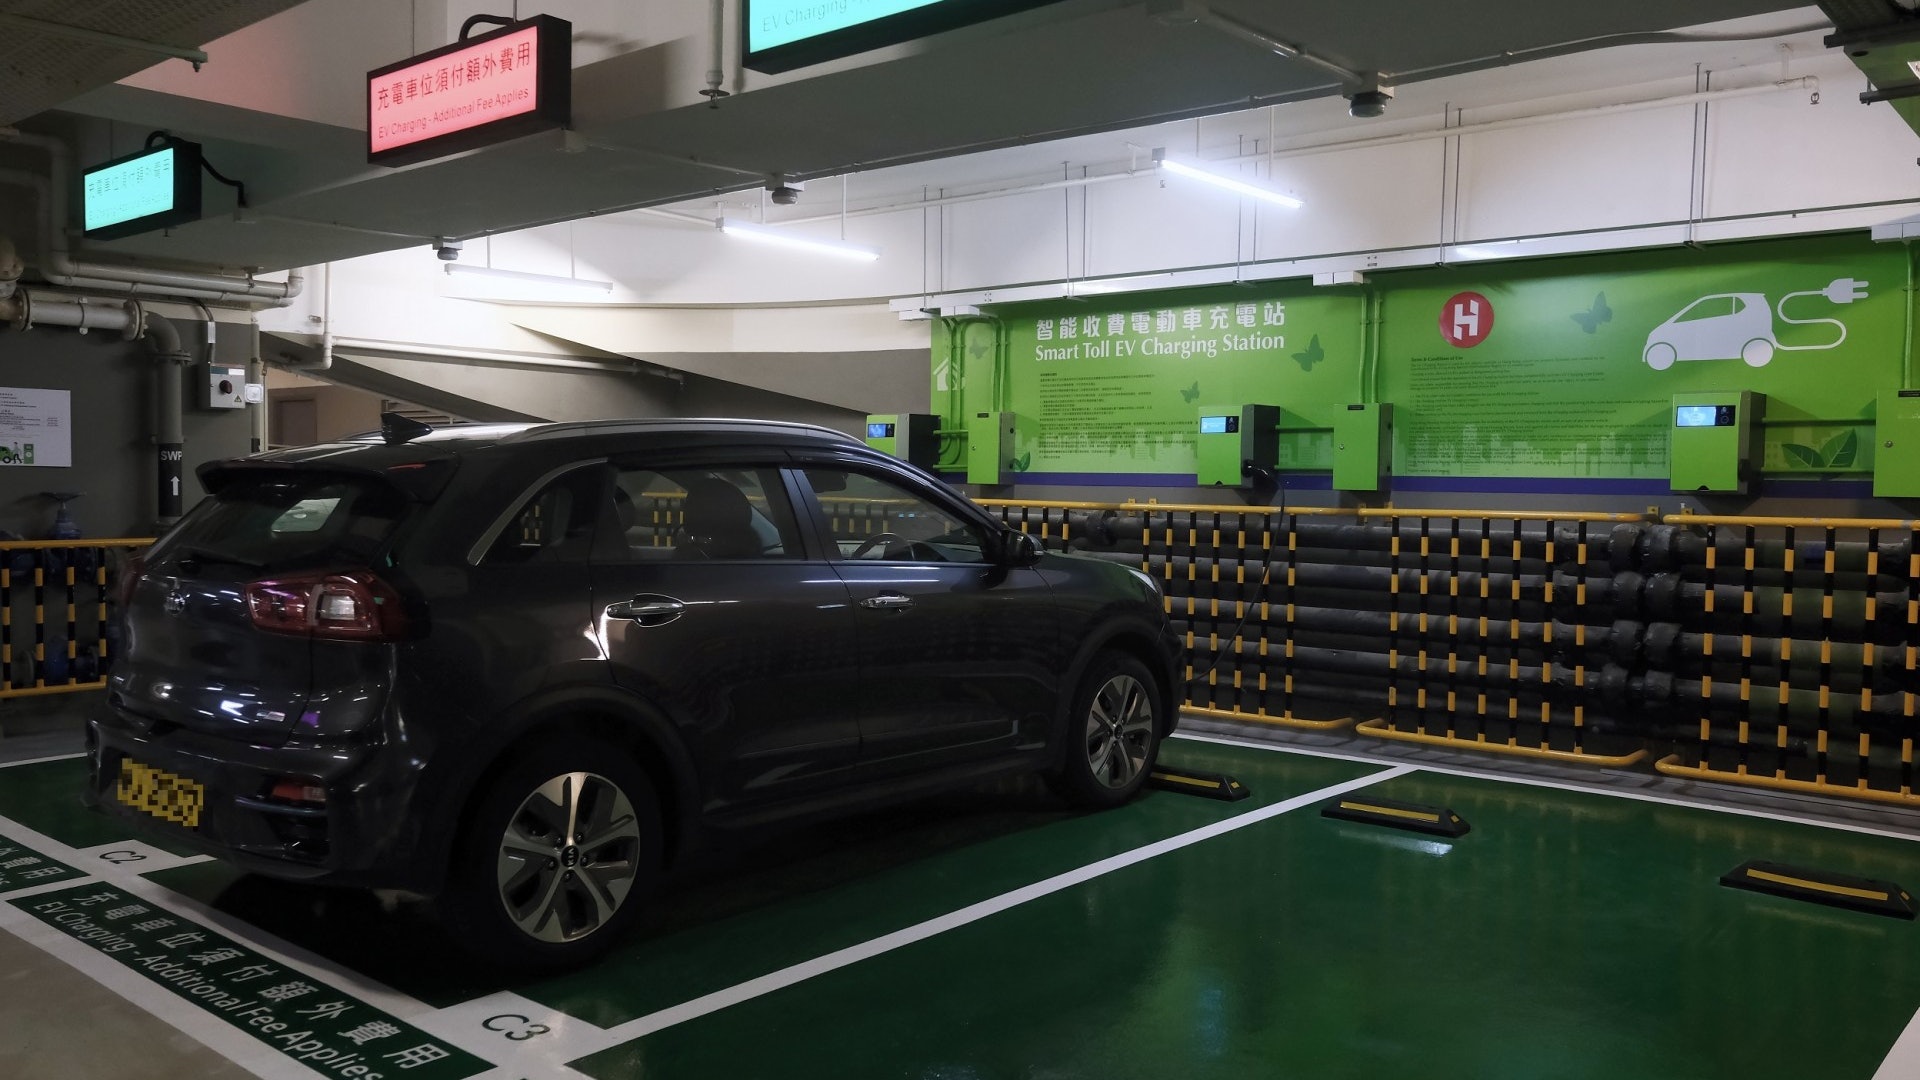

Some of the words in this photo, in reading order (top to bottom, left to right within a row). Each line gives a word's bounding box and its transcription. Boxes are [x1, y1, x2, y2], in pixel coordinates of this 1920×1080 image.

[763, 15, 781, 32] EV
[785, 1, 848, 25] Charging
[377, 41, 530, 111] 充電車位須付額外費用
[378, 126, 389, 139] EV
[391, 117, 427, 135] Charging
[433, 101, 475, 123] Additional
[477, 99, 493, 112] Fee
[495, 87, 529, 107] Applies
[1036, 301, 1286, 341] 智能收費電動車充電站
[1035, 342, 1079, 361] Smart
[1083, 340, 1110, 359] Toll
[1116, 339, 1137, 357] EV
[1141, 335, 1217, 359] Charging
[1223, 331, 1285, 351] Station
[161, 450, 183, 461] SWP
[99, 850, 147, 865] C2
[33, 901, 74, 914] EV
[54, 912, 136, 953] Charging
[134, 954, 258, 1012] Additional
[236, 1006, 288, 1033] Fee
[274, 1030, 384, 1080] Applies
[73, 892, 450, 1069] 充電車位須付額外費用
[482, 1014, 551, 1042] C3
